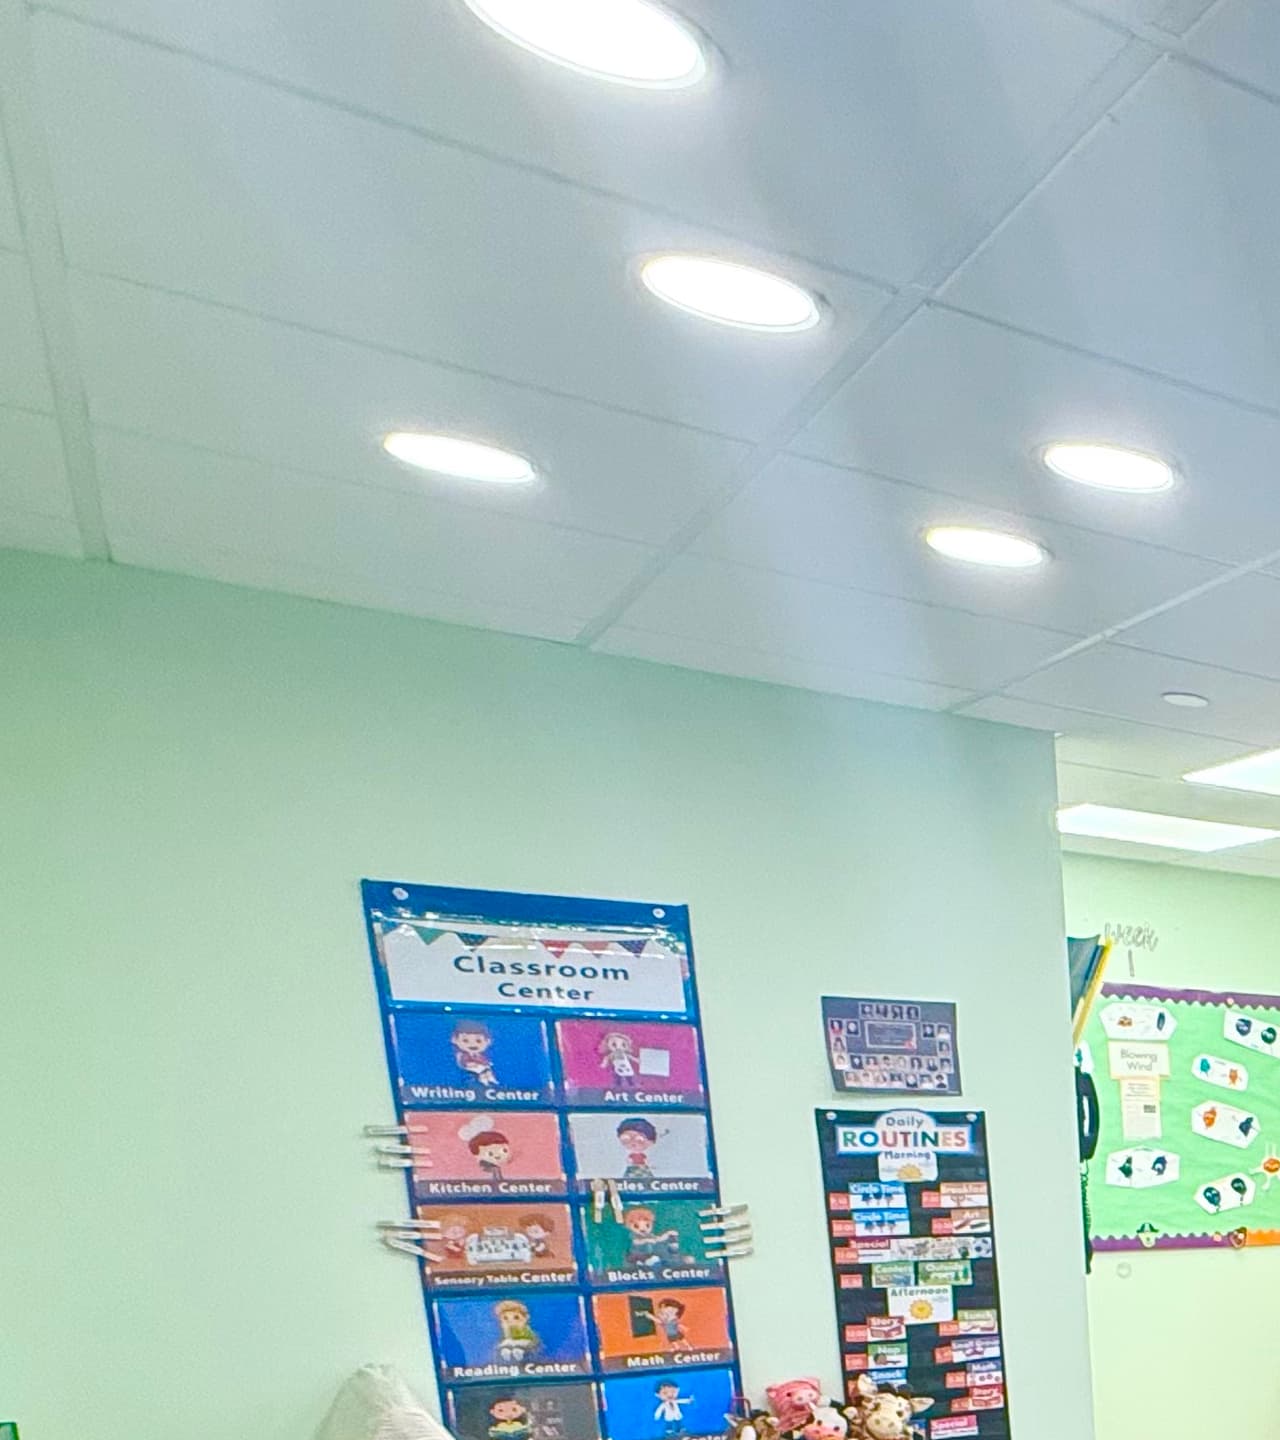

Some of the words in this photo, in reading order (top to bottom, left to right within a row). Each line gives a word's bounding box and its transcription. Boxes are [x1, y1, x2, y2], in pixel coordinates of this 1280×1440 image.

[453, 955, 630, 981] Classroom
[498, 982, 594, 1001] Center
[411, 1087, 476, 1102] Writing
[485, 1089, 540, 1101] Center
[604, 1091, 629, 1103] Art
[635, 1092, 684, 1103] Center
[886, 1117, 924, 1128] Daily
[842, 1131, 966, 1148] ROUTINES
[429, 1181, 492, 1194] Kitchen
[499, 1182, 552, 1194] Center
[650, 1180, 699, 1191] Center
[434, 1275, 484, 1286] Sensory
[521, 1271, 573, 1284] Center
[608, 1269, 654, 1282] Blocks
[662, 1268, 711, 1280] Center
[627, 1355, 664, 1368] Math
[674, 1351, 721, 1365] Center
[454, 1364, 520, 1378] Reading
[525, 1362, 577, 1374] Center
